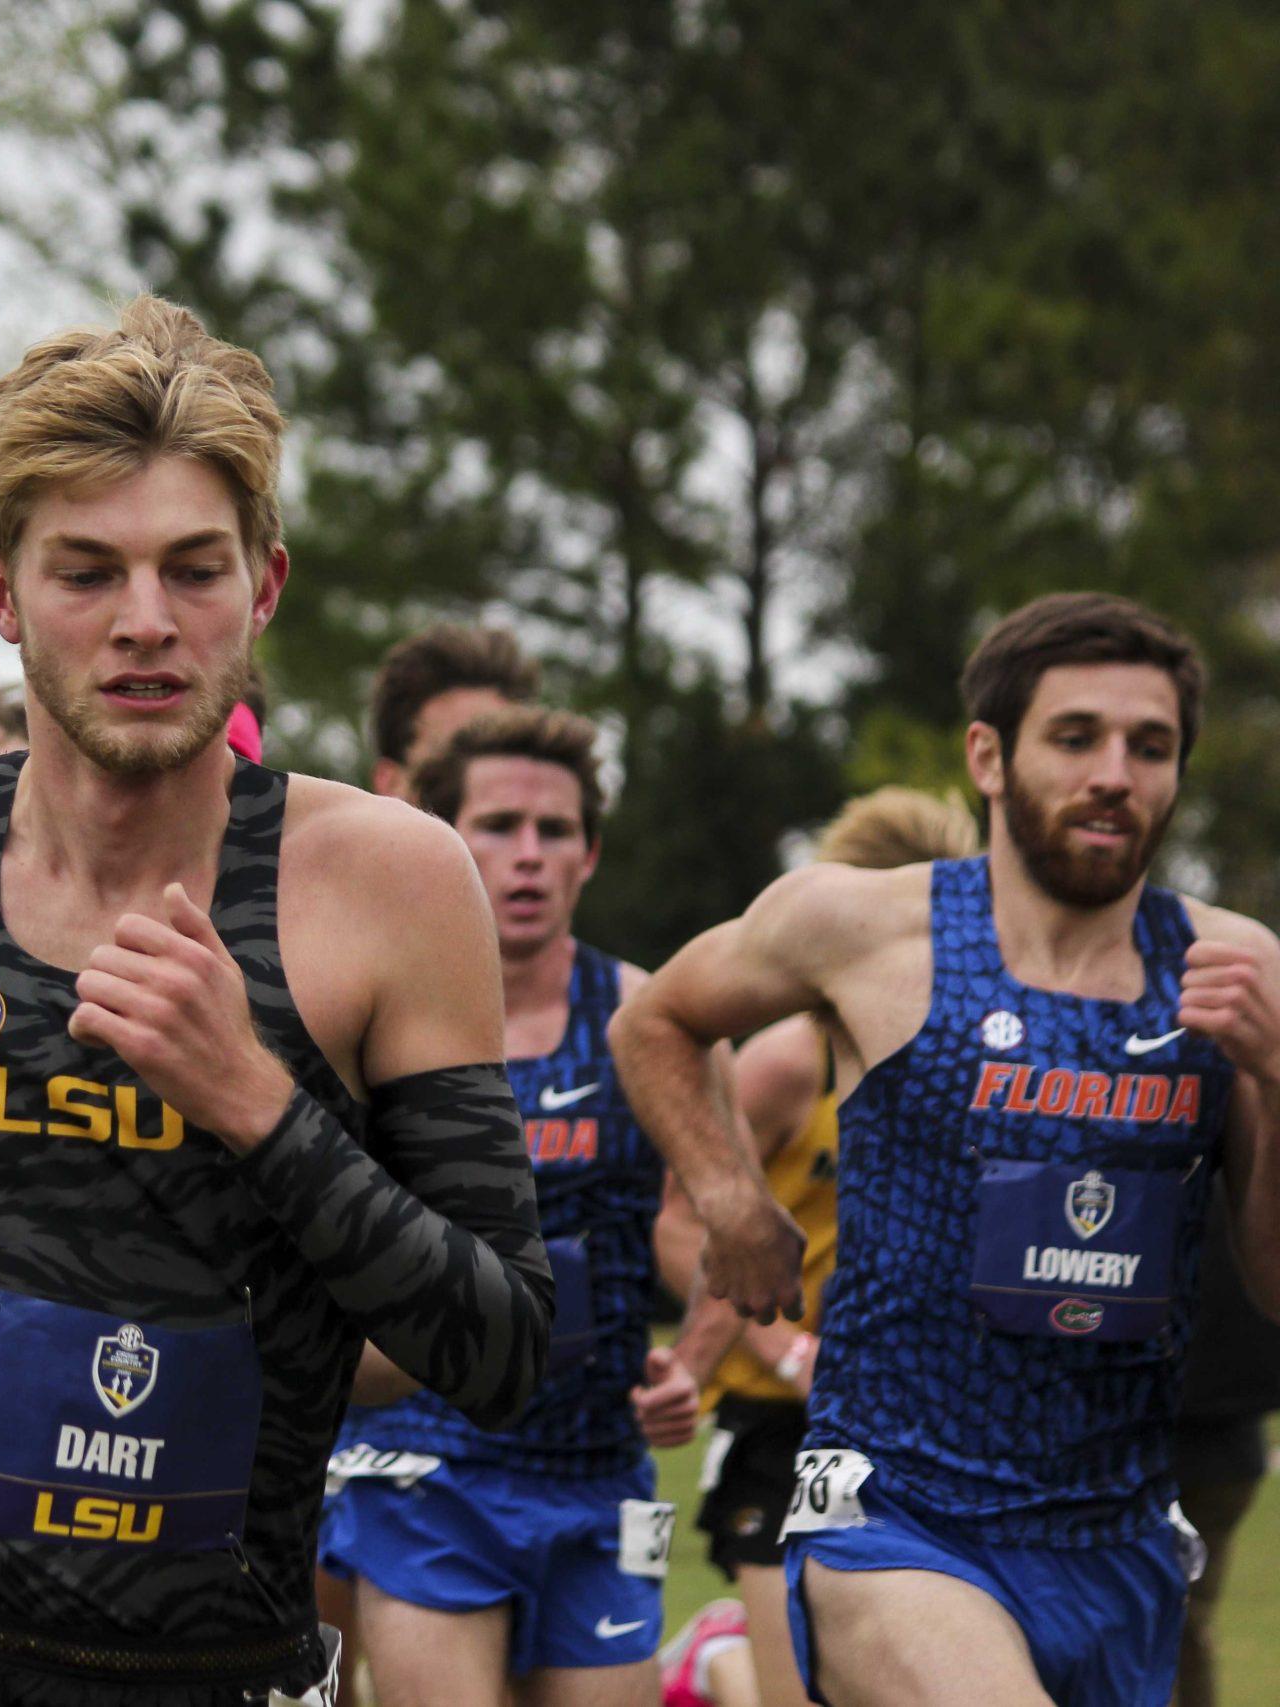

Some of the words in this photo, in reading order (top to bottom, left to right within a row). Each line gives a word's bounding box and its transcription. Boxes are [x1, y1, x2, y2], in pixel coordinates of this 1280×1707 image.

[969, 1060, 1201, 1124] FLORIDA
[1023, 1245, 1141, 1288] LOWERY
[55, 1424, 165, 1481] DART
[33, 1492, 163, 1544] LSU
